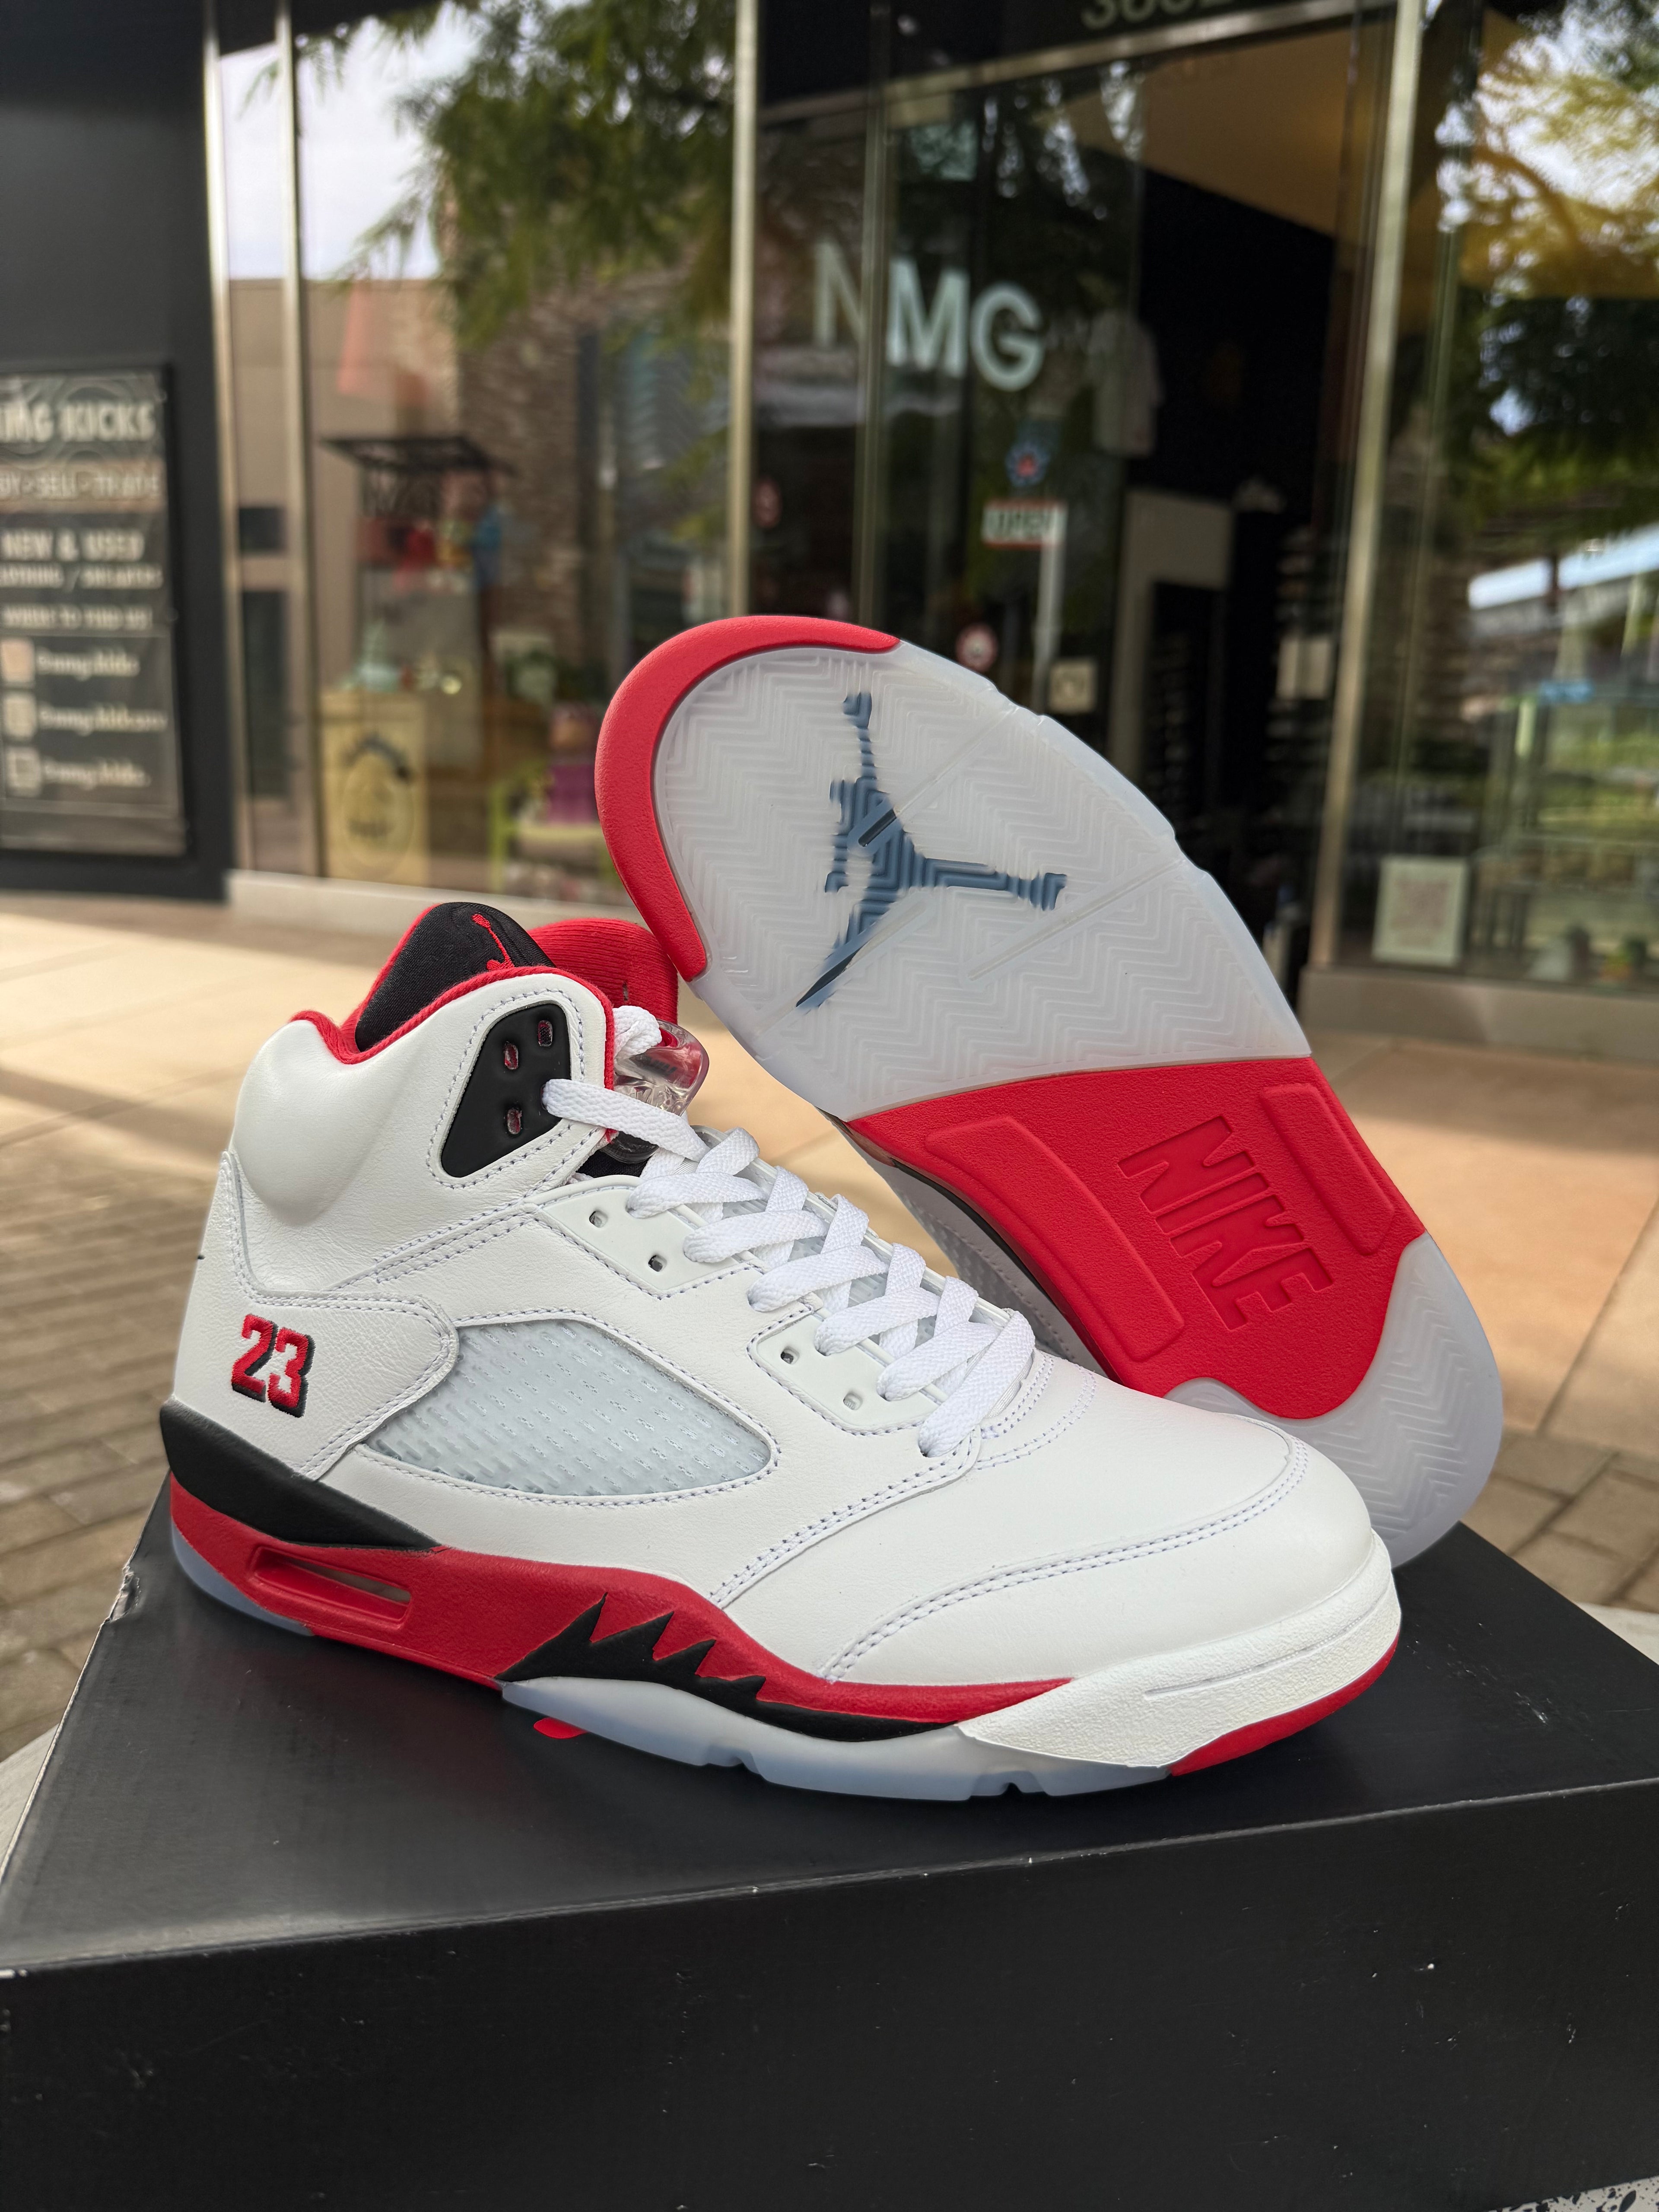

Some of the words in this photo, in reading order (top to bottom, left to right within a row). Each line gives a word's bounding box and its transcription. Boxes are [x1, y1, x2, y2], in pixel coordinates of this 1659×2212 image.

[812, 235, 1045, 391] NMG
[63, 400, 155, 442] KICKS
[3, 528, 53, 561] NEW
[1117, 1116, 1334, 1332] NIKE
[231, 1313, 316, 1418] 23
